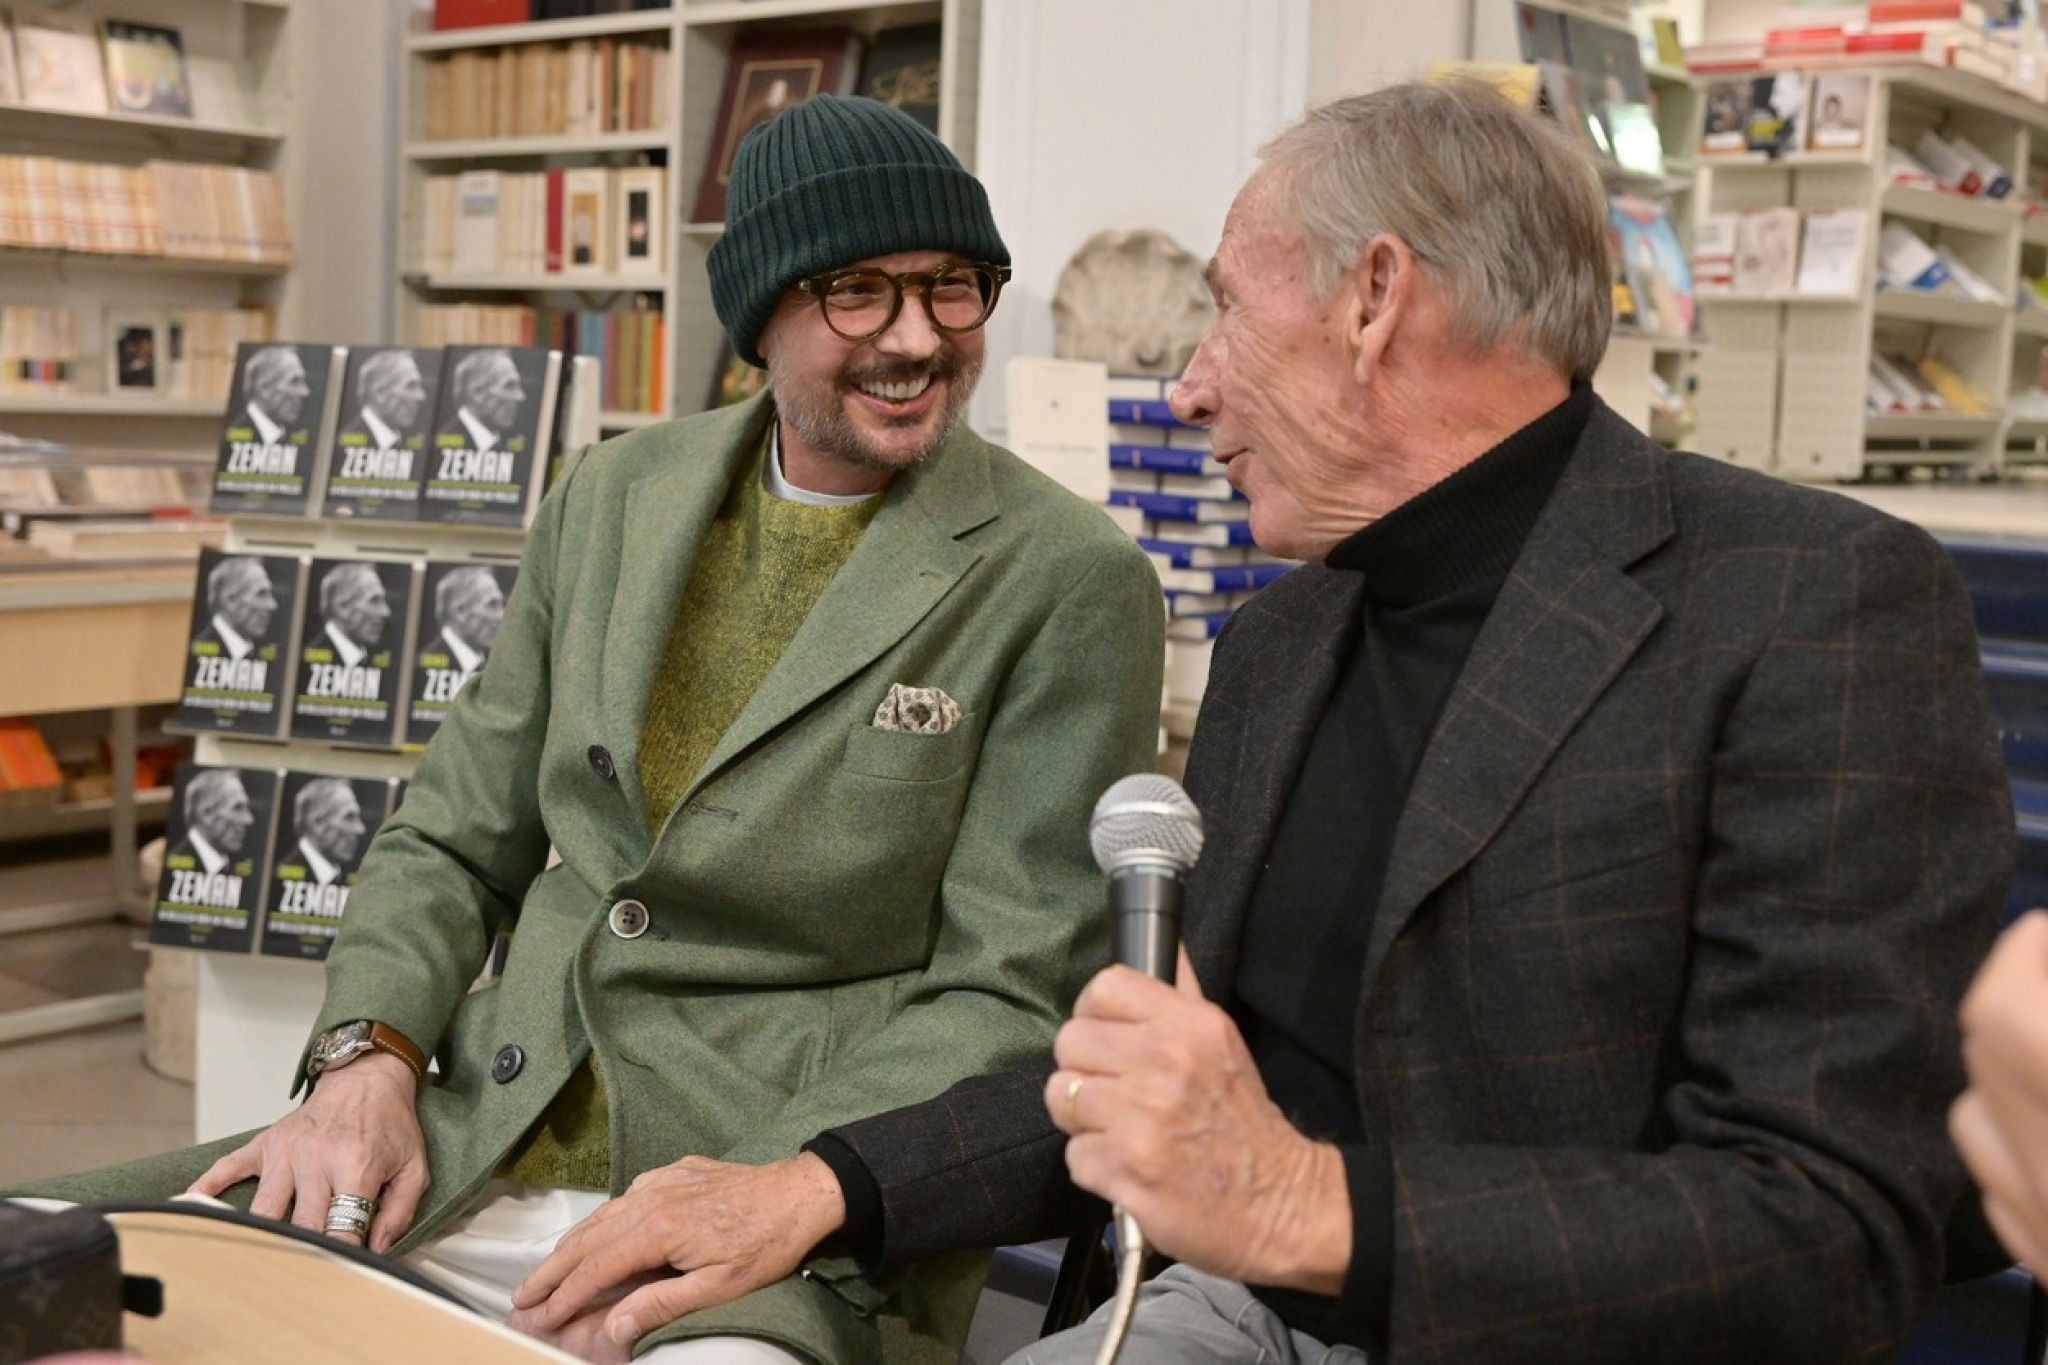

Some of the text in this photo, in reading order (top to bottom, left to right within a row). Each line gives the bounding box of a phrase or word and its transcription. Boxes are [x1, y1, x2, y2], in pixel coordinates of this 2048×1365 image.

[227, 442, 298, 475] ZEMAN
[341, 447, 413, 480] ZEMAN
[438, 449, 514, 483] ZEMAN
[195, 656, 267, 693] ZEMAN
[307, 663, 381, 701] ZEMAN
[169, 870, 242, 908] ZEMAN
